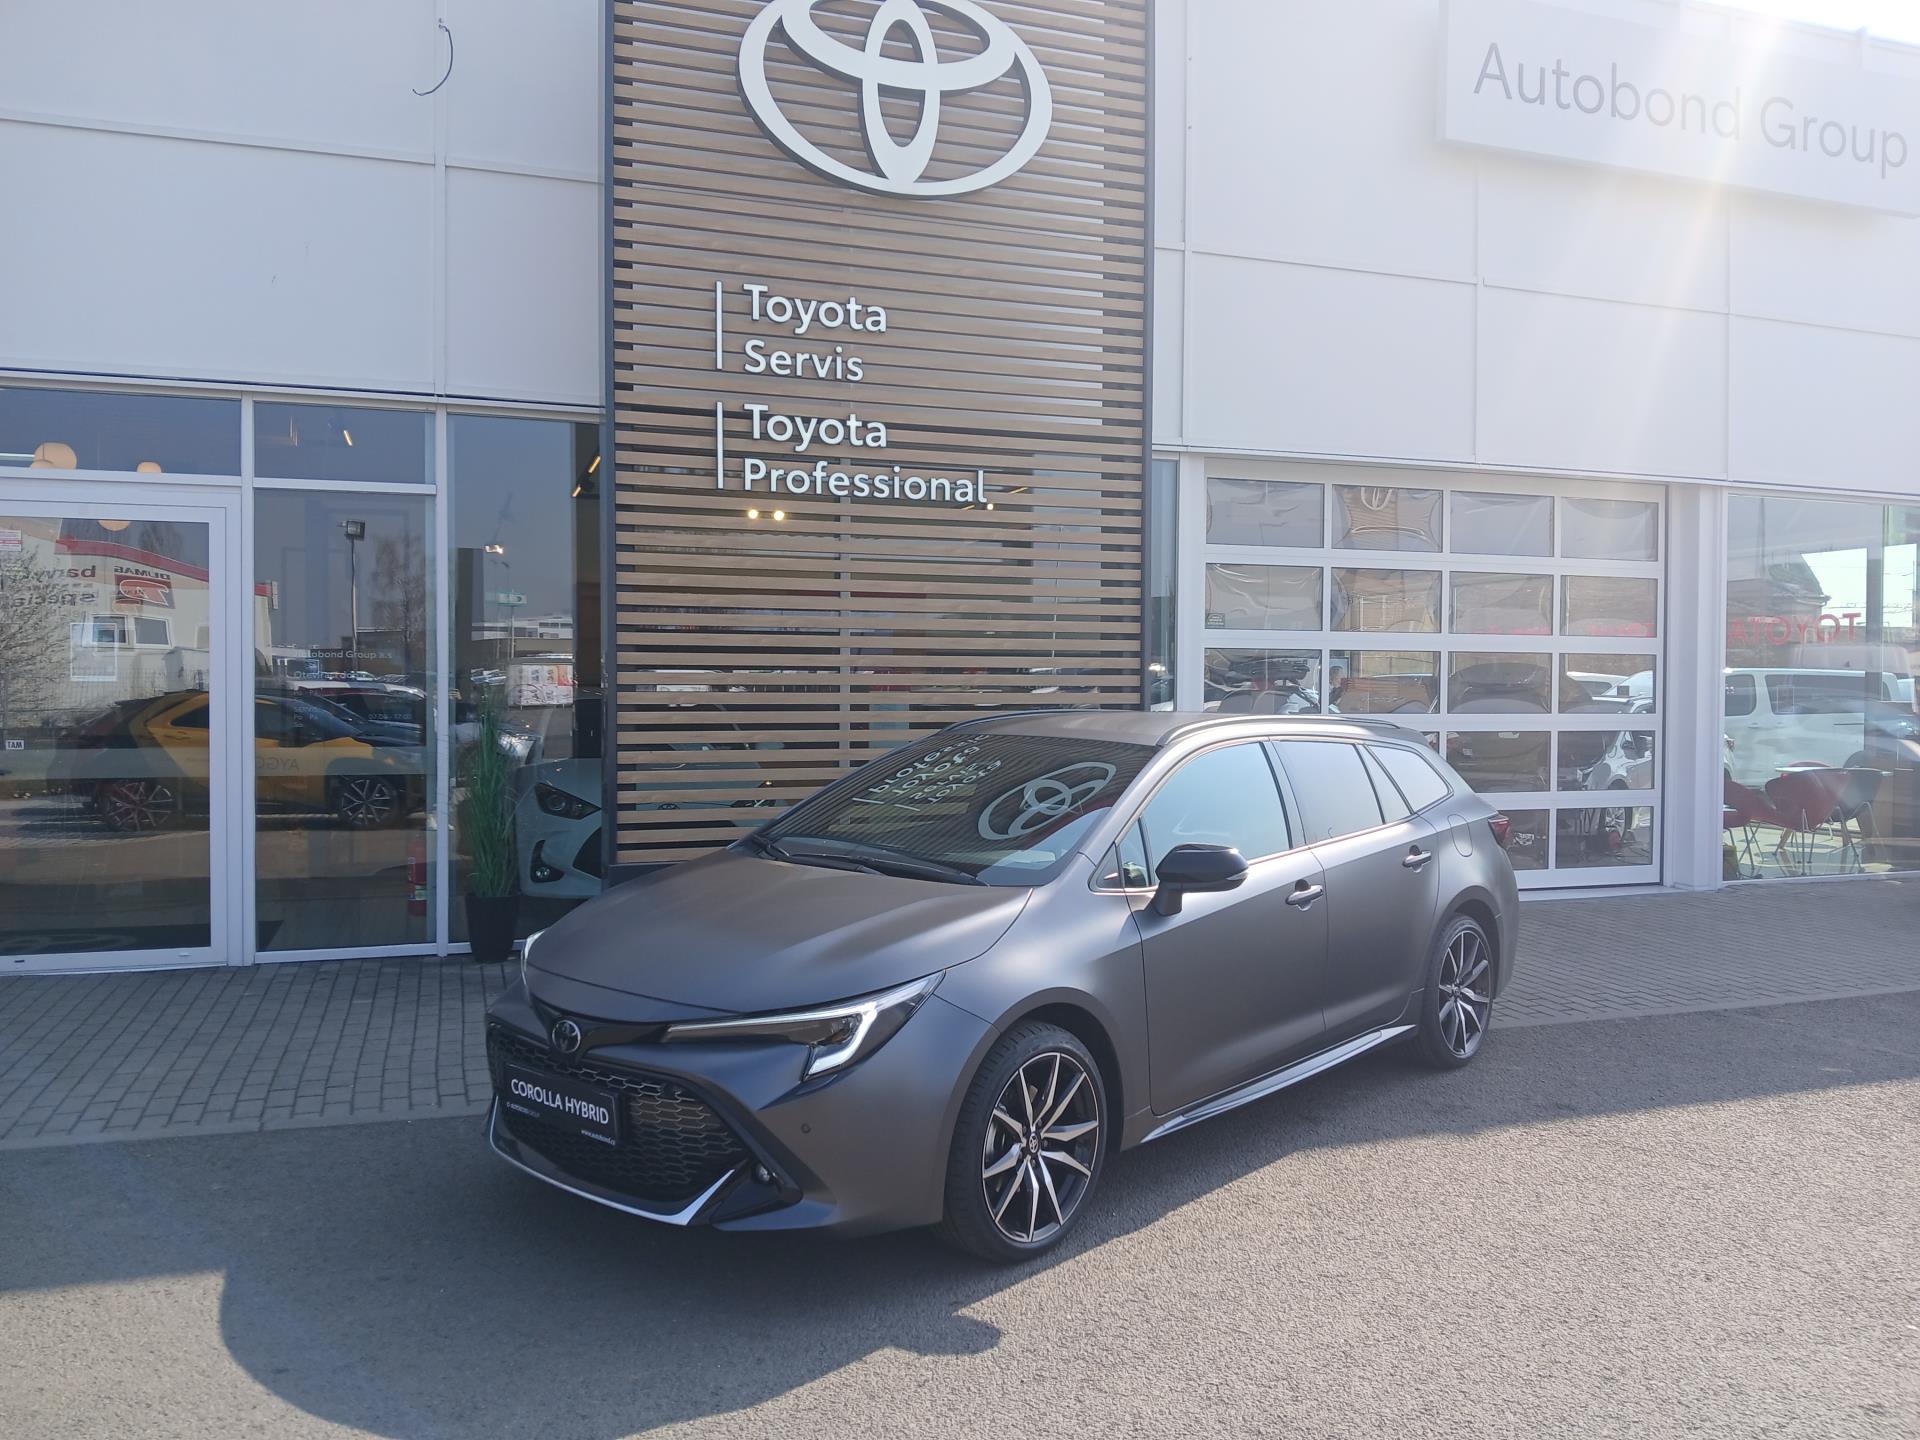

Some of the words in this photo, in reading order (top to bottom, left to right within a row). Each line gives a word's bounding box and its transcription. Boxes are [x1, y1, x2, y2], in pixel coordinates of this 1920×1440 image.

[1473, 42, 1741, 141] Autobond
[1760, 97, 1908, 179] Group
[743, 283, 887, 337] Toyota
[743, 340, 864, 382] Servis
[743, 403, 887, 453] Toyota
[744, 458, 987, 504] Professional
[295, 649, 344, 659] utobond
[510, 1078, 563, 1110] COROLLA
[564, 1095, 609, 1125] HYBRID
